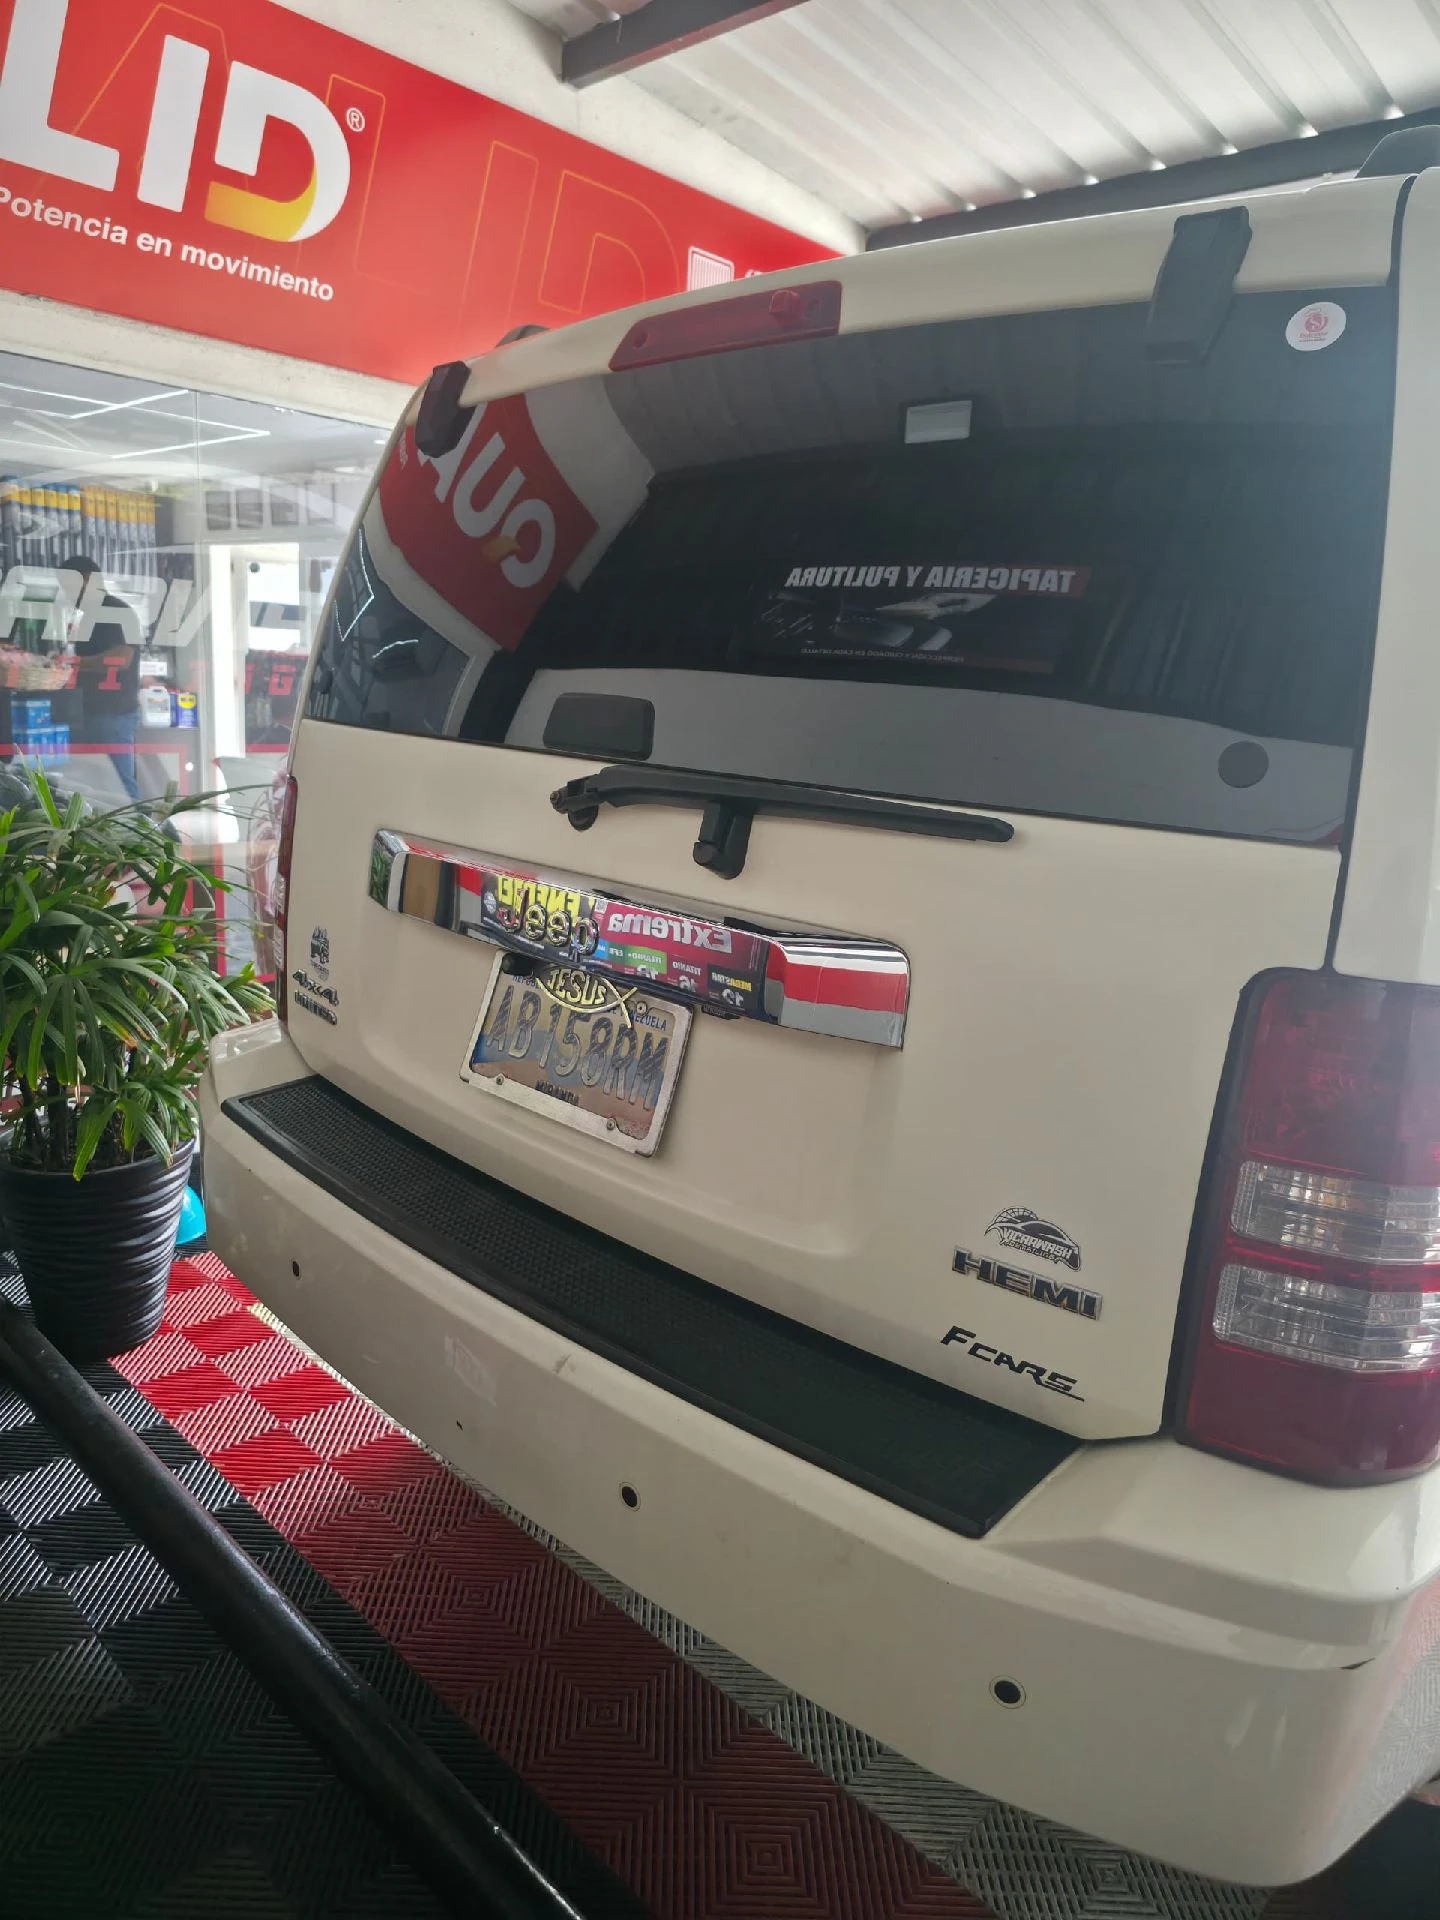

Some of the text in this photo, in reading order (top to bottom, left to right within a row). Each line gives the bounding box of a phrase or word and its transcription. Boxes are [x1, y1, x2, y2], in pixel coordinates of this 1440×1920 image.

[136, 231, 172, 257] en
[180, 242, 334, 301] movimiento
[498, 887, 600, 961] Jeep
[547, 967, 607, 1005] JESUS
[485, 984, 670, 1110] AB158RM
[952, 1246, 1103, 1321] HEMI
